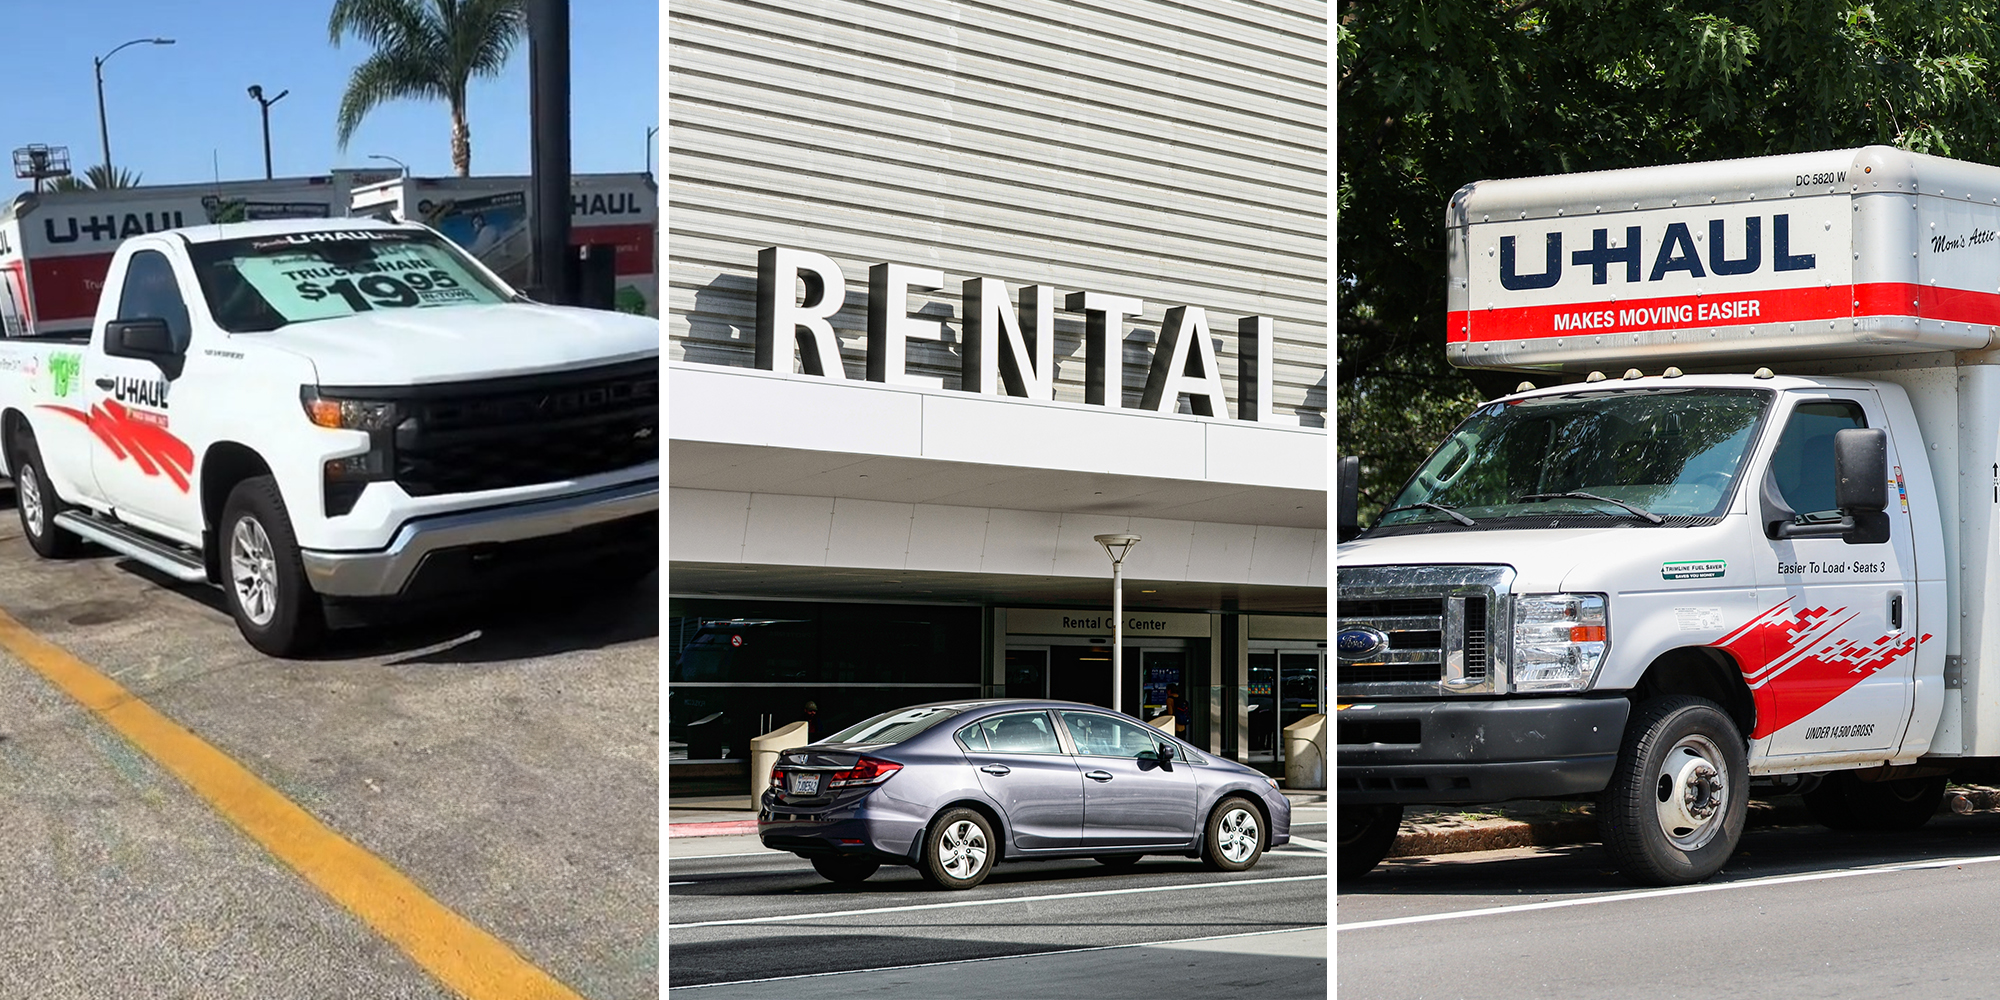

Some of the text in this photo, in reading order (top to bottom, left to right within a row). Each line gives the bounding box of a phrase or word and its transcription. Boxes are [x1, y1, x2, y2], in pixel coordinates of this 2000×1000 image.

[1796, 171, 1847, 186] DC 5820 W
[1931, 227, 1996, 253] Mom's Attic
[1500, 214, 1816, 291] U-HAUL
[1554, 299, 1760, 331] MAKES MOVING EASIER
[755, 246, 1300, 426] RENTAL
[1778, 561, 1886, 574] Easier To Load Seats 3
[1063, 616, 1100, 629] Rental
[1128, 618, 1166, 630] Center
[1341, 635, 1367, 649] Ford
[1805, 726, 1831, 740] UNDER
[1850, 723, 1875, 737] GROSS
